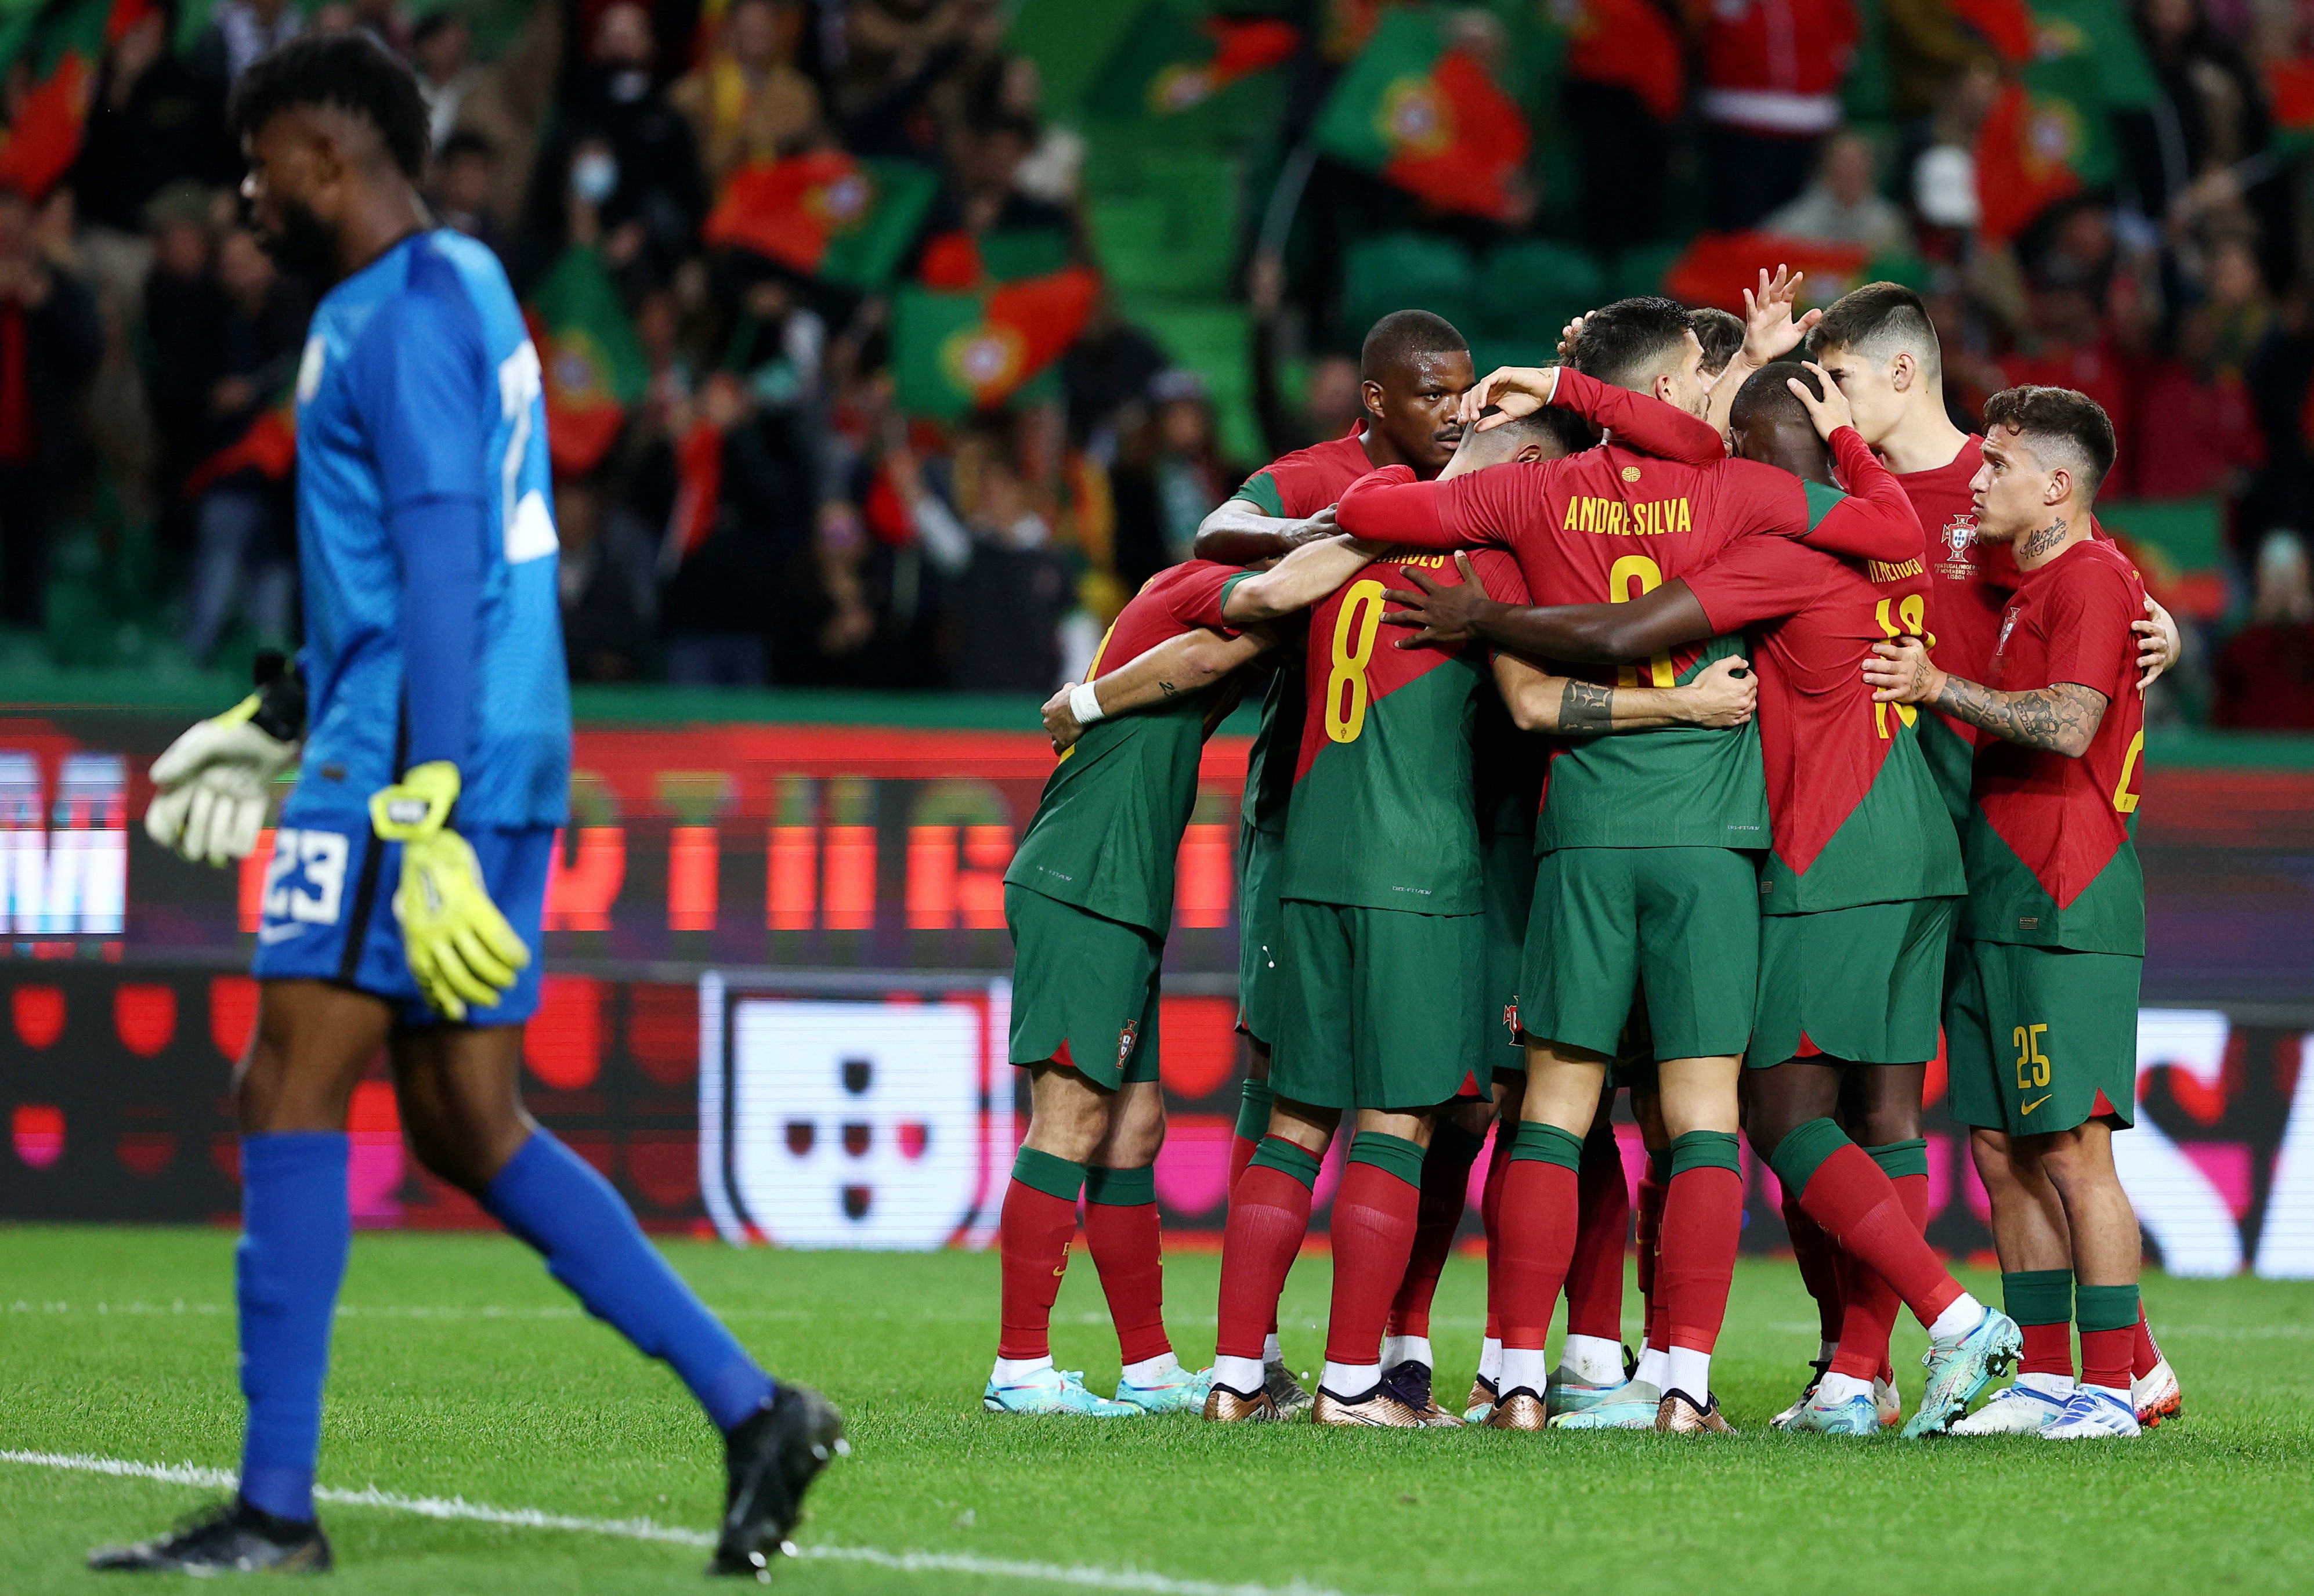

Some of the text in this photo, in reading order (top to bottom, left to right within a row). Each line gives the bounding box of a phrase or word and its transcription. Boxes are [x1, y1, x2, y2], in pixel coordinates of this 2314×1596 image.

[1633, 497, 1691, 535] SILVA
[1325, 579, 1386, 743] 8
[263, 828, 349, 925] 23
[2013, 1023, 2051, 1089] 25
